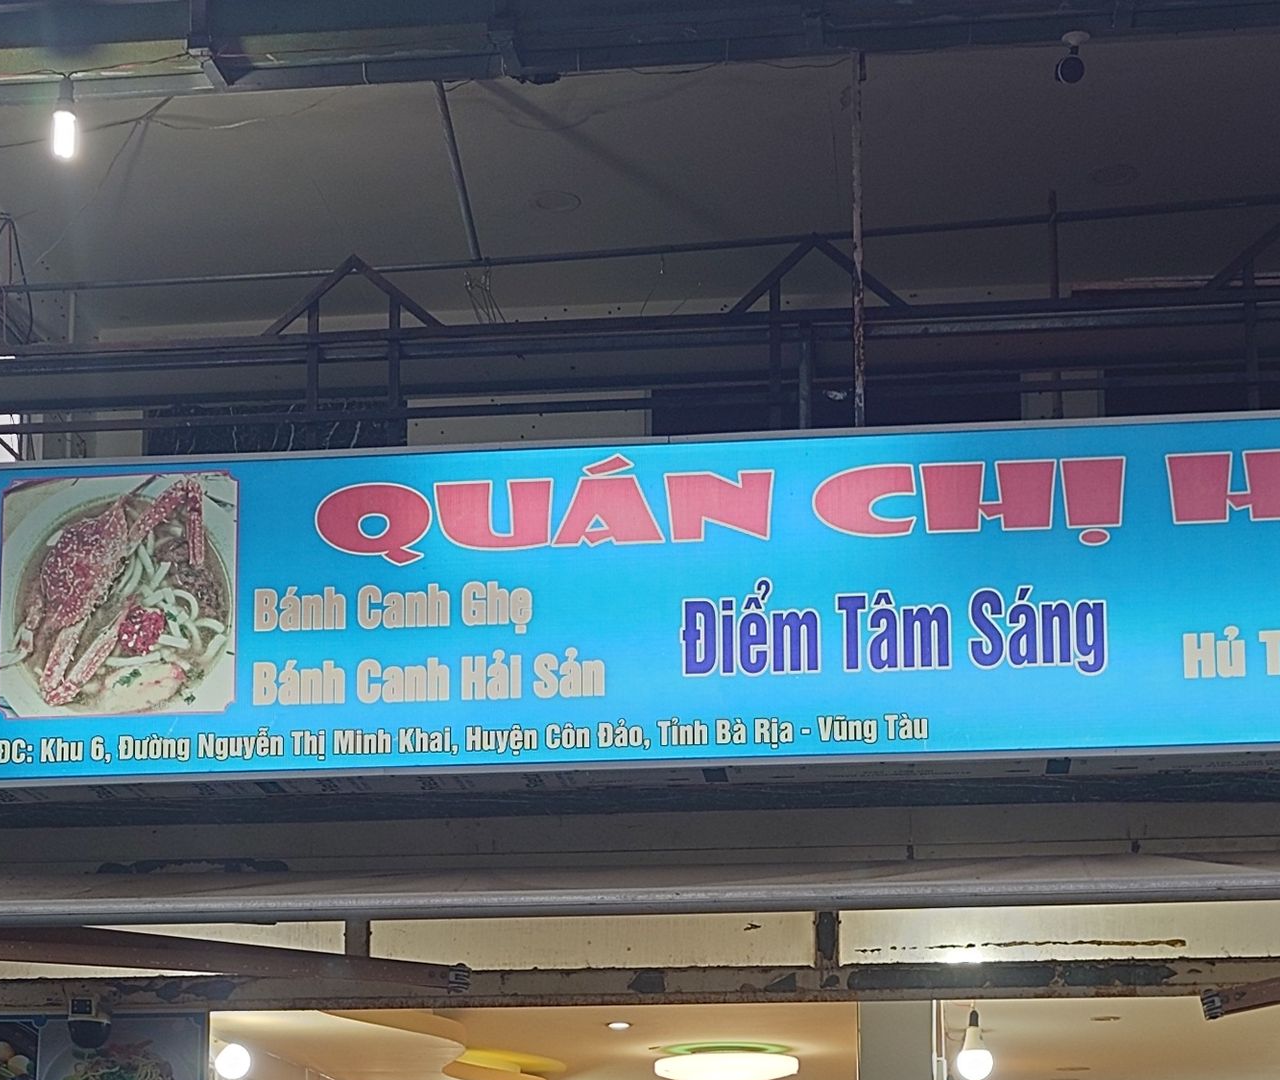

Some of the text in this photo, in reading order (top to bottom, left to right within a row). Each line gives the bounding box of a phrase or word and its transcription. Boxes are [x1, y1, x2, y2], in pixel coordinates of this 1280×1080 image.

[315, 453, 774, 566] QUÁN
[811, 456, 1126, 546] CHỊ
[253, 581, 533, 634] Bánh Canh Ghẹ
[680, 577, 1107, 676] Điểm Tâm Sáng
[252, 646, 605, 706] Bánh Canh Hải Sản
[1183, 626, 1246, 679] Hủ
[40, 737, 82, 762] Khu
[90, 736, 112, 764] 6,
[118, 733, 190, 762] Đường
[198, 727, 284, 761] Nguyễn
[290, 730, 326, 761] Thị
[333, 729, 391, 756] Minh
[398, 727, 459, 756] Khai,
[466, 724, 538, 756] Huyện
[546, 723, 591, 750] Côn
[598, 718, 651, 750] Đảo,
[657, 716, 708, 747] Tỉnh
[716, 719, 748, 745] Bà
[755, 718, 794, 750] Rịa
[818, 715, 878, 744] Vũng
[885, 713, 928, 741] Tàu
